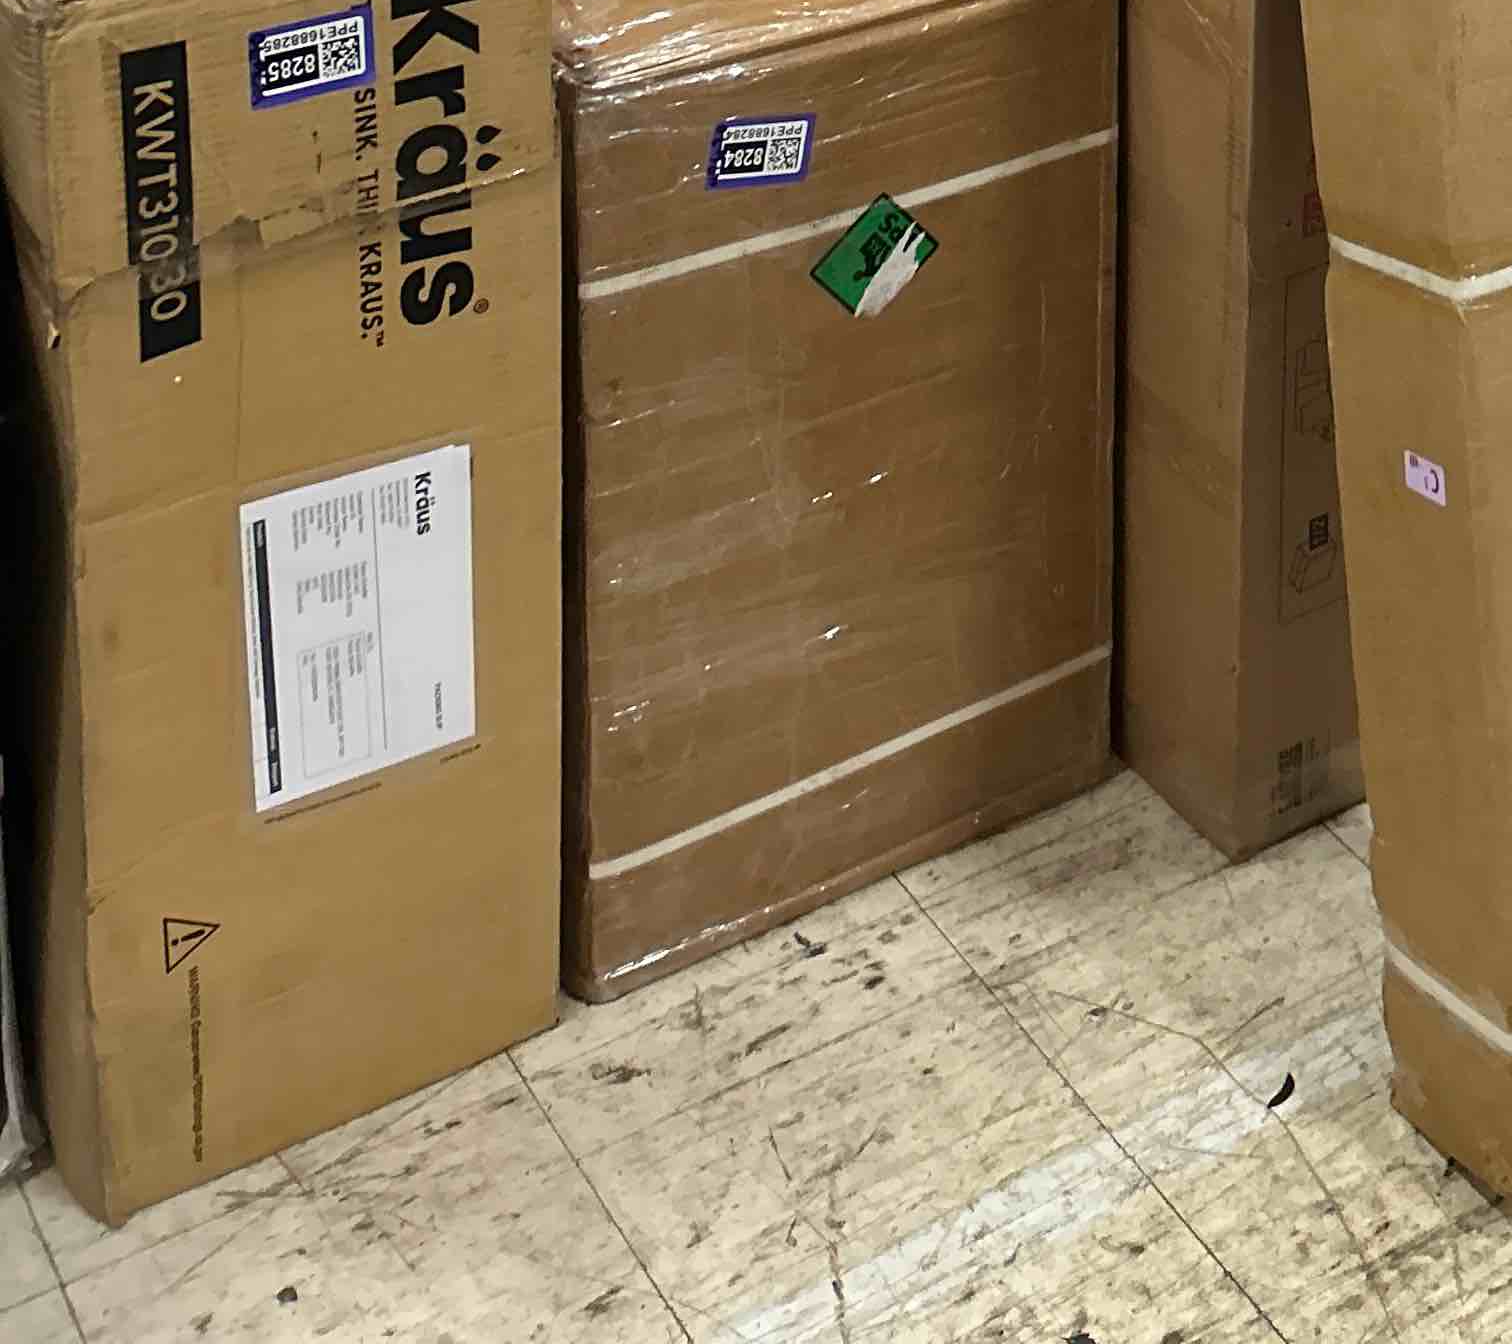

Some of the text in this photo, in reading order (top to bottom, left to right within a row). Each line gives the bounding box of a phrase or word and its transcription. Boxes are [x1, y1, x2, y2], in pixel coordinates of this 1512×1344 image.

[267, 53, 316, 83] 8285
[352, 87, 377, 162] SINK.
[724, 147, 764, 169] 8284
[356, 169, 380, 239] THI.
[414, 471, 436, 536] Kräus
